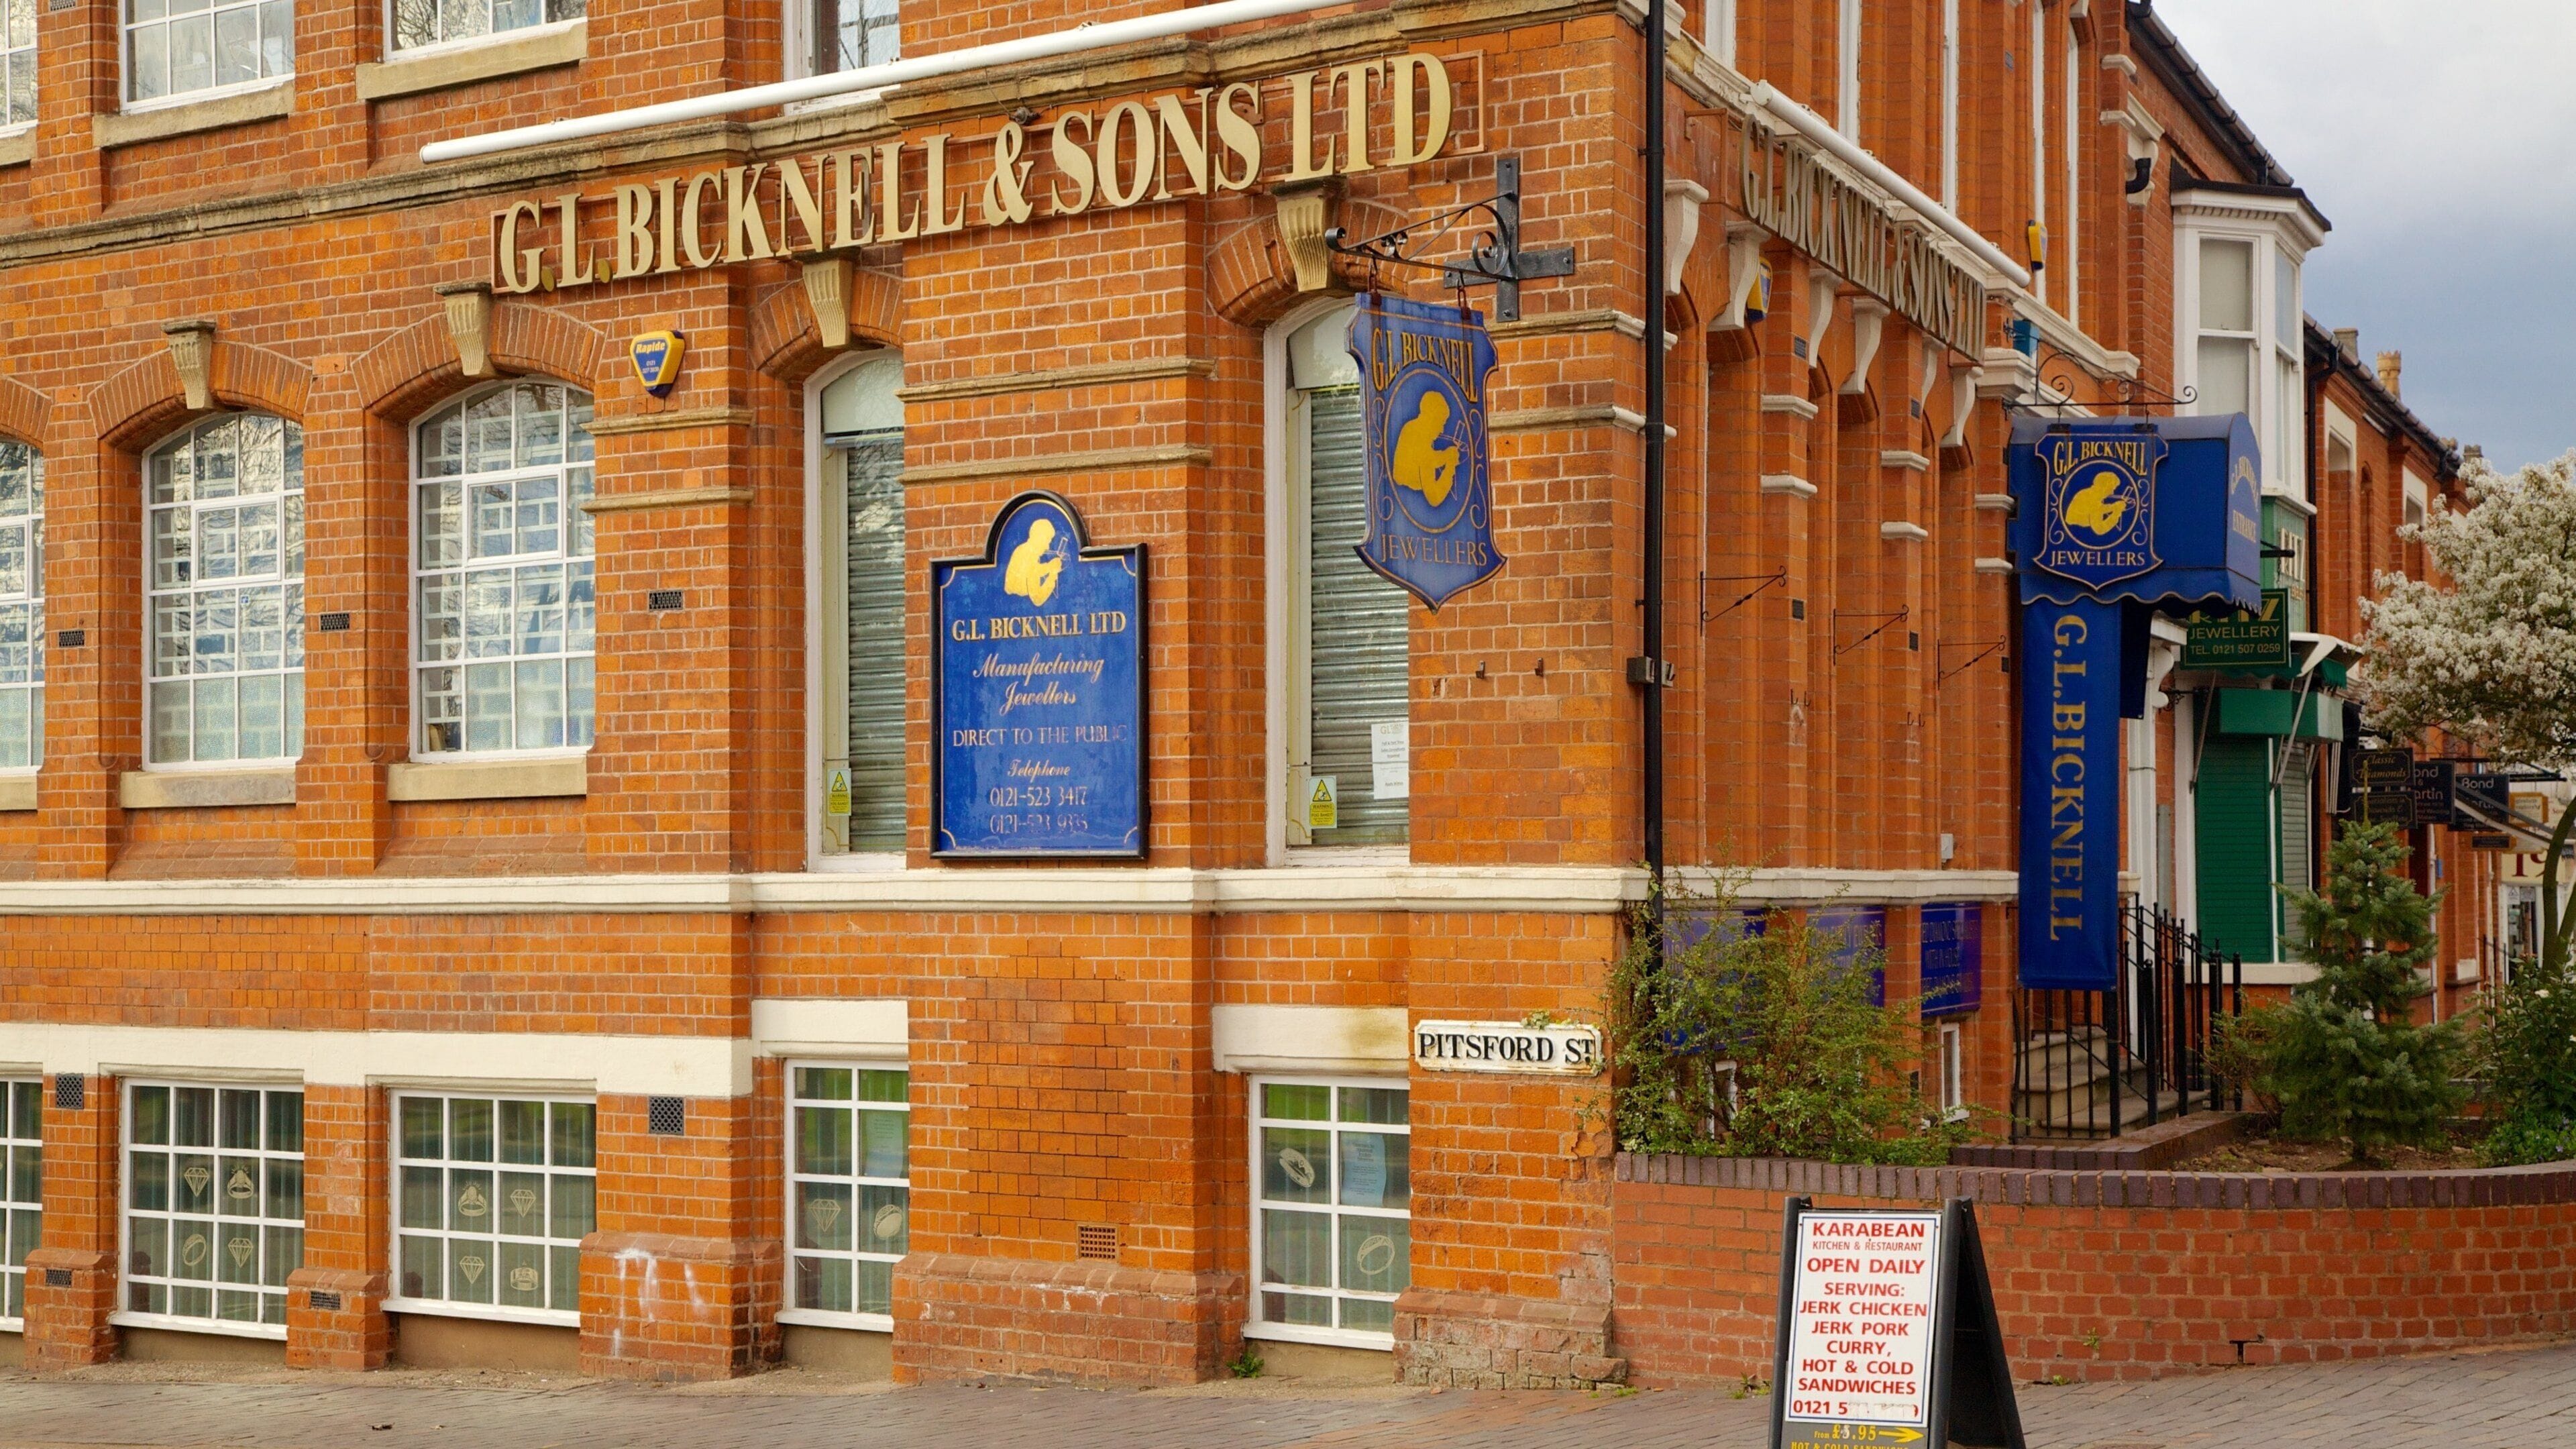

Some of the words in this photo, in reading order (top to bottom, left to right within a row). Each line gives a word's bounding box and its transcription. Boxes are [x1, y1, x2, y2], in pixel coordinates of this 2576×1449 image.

[983, 121, 1034, 227] &
[1051, 81, 1263, 216] SONS
[1285, 52, 1453, 182] LTD
[1893, 224, 1907, 313] &
[1907, 233, 1953, 344] SONS
[1953, 266, 1986, 366] LTD
[2080, 441, 2147, 476] BICKNELL
[1382, 535, 1487, 567] JEWELLERS
[2049, 550, 2145, 567] JEWELLERS
[951, 619, 985, 642] G.L.
[990, 614, 1083, 640] BICKNELL
[1089, 610, 1126, 635] LTD
[2190, 625, 2279, 640] JEWELLERY
[2213, 644, 2235, 654] 0121
[2238, 644, 2255, 654] 507
[2257, 643, 2281, 653] 0259
[973, 651, 1105, 687] Manufacturing
[1000, 680, 1076, 716] Jewellers
[953, 729, 1007, 747] DIRECT
[1011, 727, 1033, 745] TO
[1037, 726, 1069, 744] THE
[1008, 759, 1071, 784] Telephone
[2461, 777, 2494, 789] Bond
[989, 787, 1051, 807] 0121-523
[1058, 786, 1088, 806] 3417
[1417, 1032, 1554, 1063] PITSFORD
[1813, 1222, 1925, 1238] KARABEAN
[1813, 1241, 1850, 1250] KITCHEN
[1854, 1242, 1861, 1250] &
[1865, 1242, 1923, 1252] RESTAURANT
[1807, 1258, 1860, 1273] OPEN
[1869, 1258, 1925, 1274] DAILY
[1824, 1282, 1905, 1297] SERVING:
[1800, 1301, 1841, 1315] JERK
[1849, 1301, 1927, 1317] CHICKEN
[1811, 1321, 1853, 1335] JERK
[1862, 1322, 1909, 1336] PORK
[1827, 1340, 1892, 1357] CURRY,
[1803, 1359, 1837, 1373] HOT
[1845, 1360, 1858, 1373] &
[1867, 1360, 1914, 1375] COLD
[1798, 1378, 1916, 1395] SANDWICHES
[1793, 1400, 1831, 1414] 0121
[1814, 1430, 1829, 1439] From
